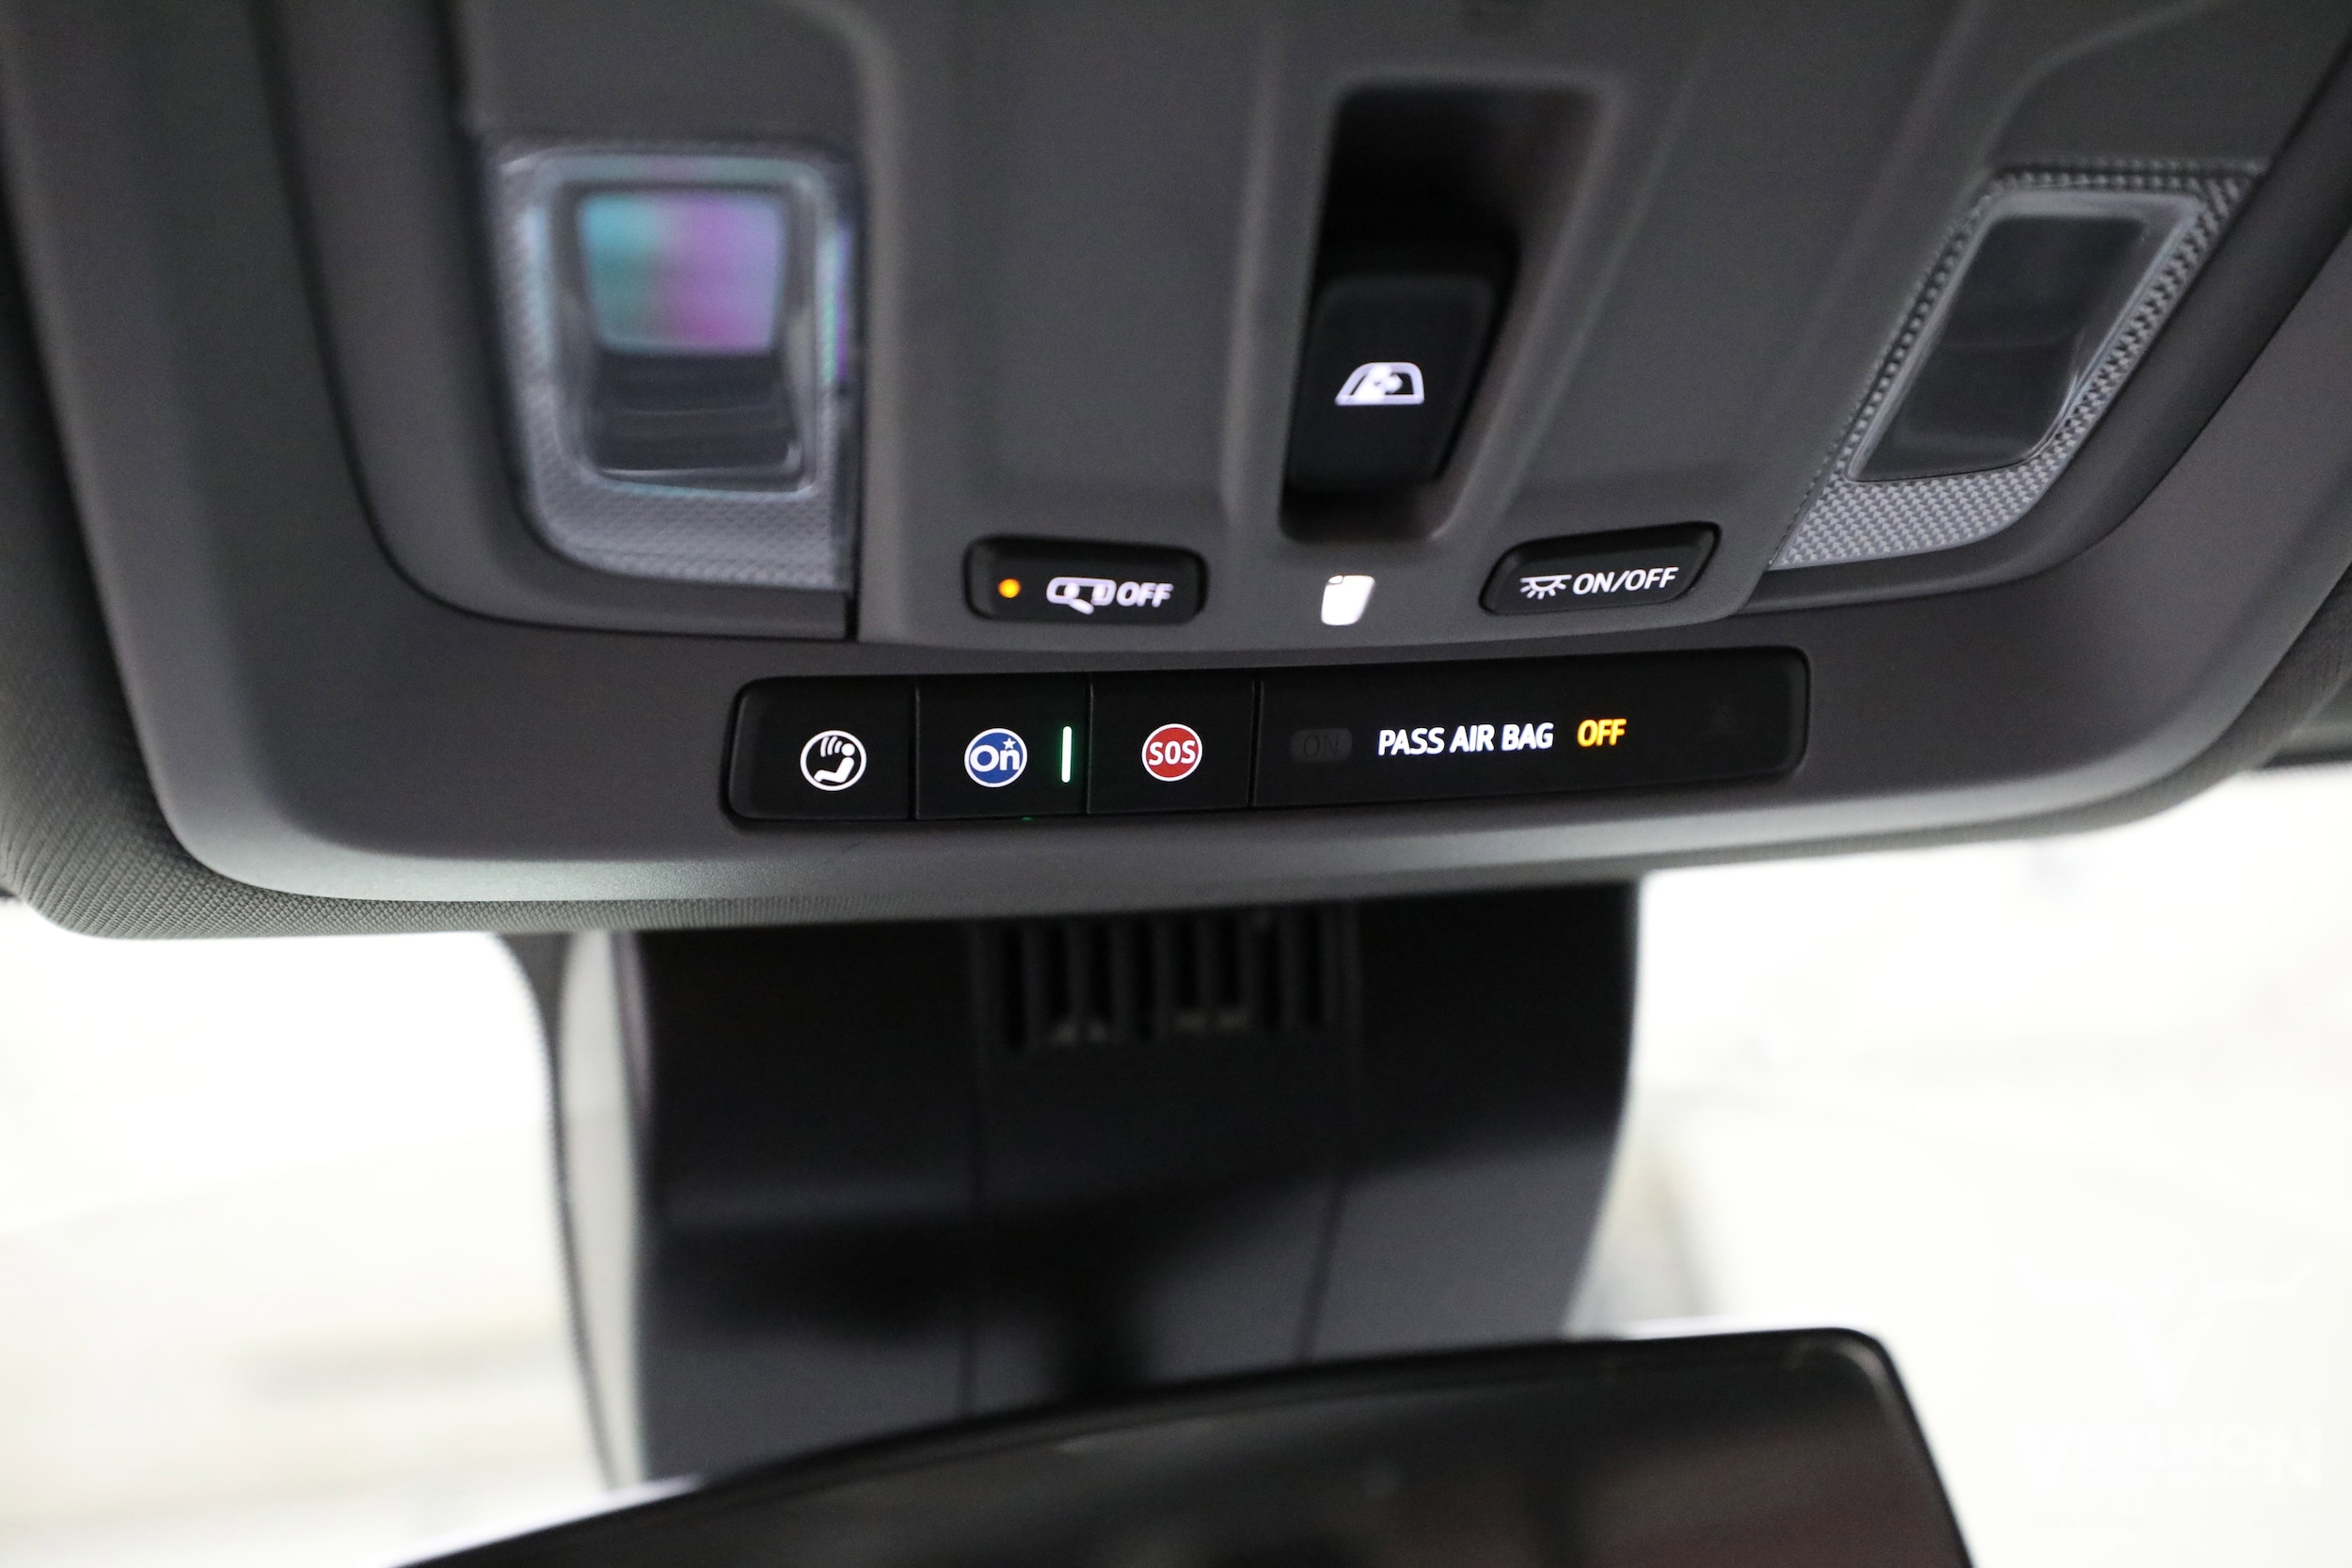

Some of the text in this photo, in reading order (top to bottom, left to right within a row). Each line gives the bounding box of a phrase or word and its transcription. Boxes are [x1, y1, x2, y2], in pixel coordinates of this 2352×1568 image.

[1116, 580, 1174, 609] OFF
[1572, 566, 1679, 595] ON/OFF
[1148, 739, 1197, 767] SOS
[1302, 718, 1628, 759] ON PASS AIR BAG OFF
